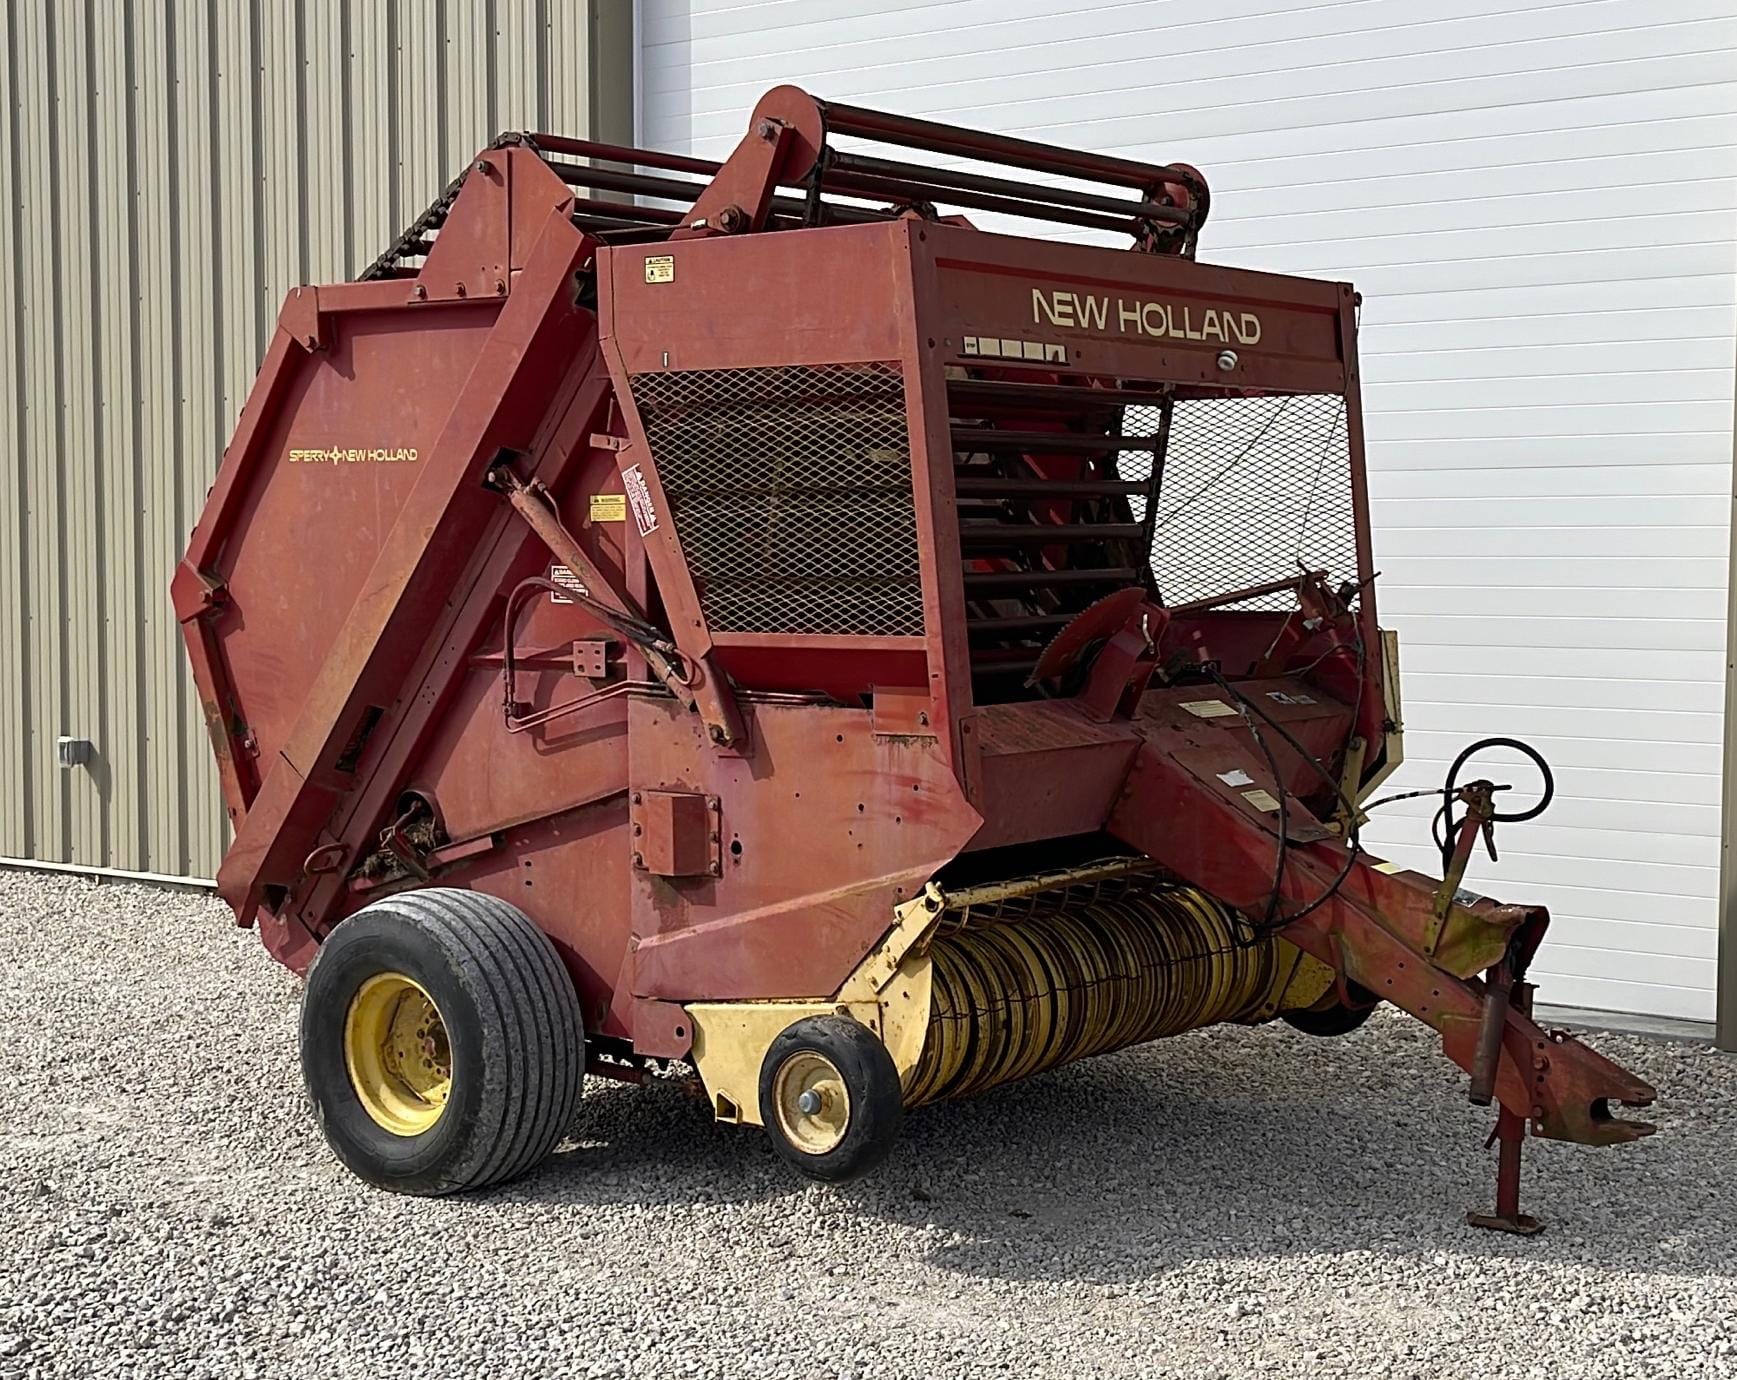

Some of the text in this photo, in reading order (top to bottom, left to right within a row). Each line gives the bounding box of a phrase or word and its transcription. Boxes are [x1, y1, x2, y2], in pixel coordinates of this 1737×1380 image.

[1032, 288, 1261, 345] NEW HOLLAND
[289, 448, 418, 462] SPERRY NEW HOLLAND
